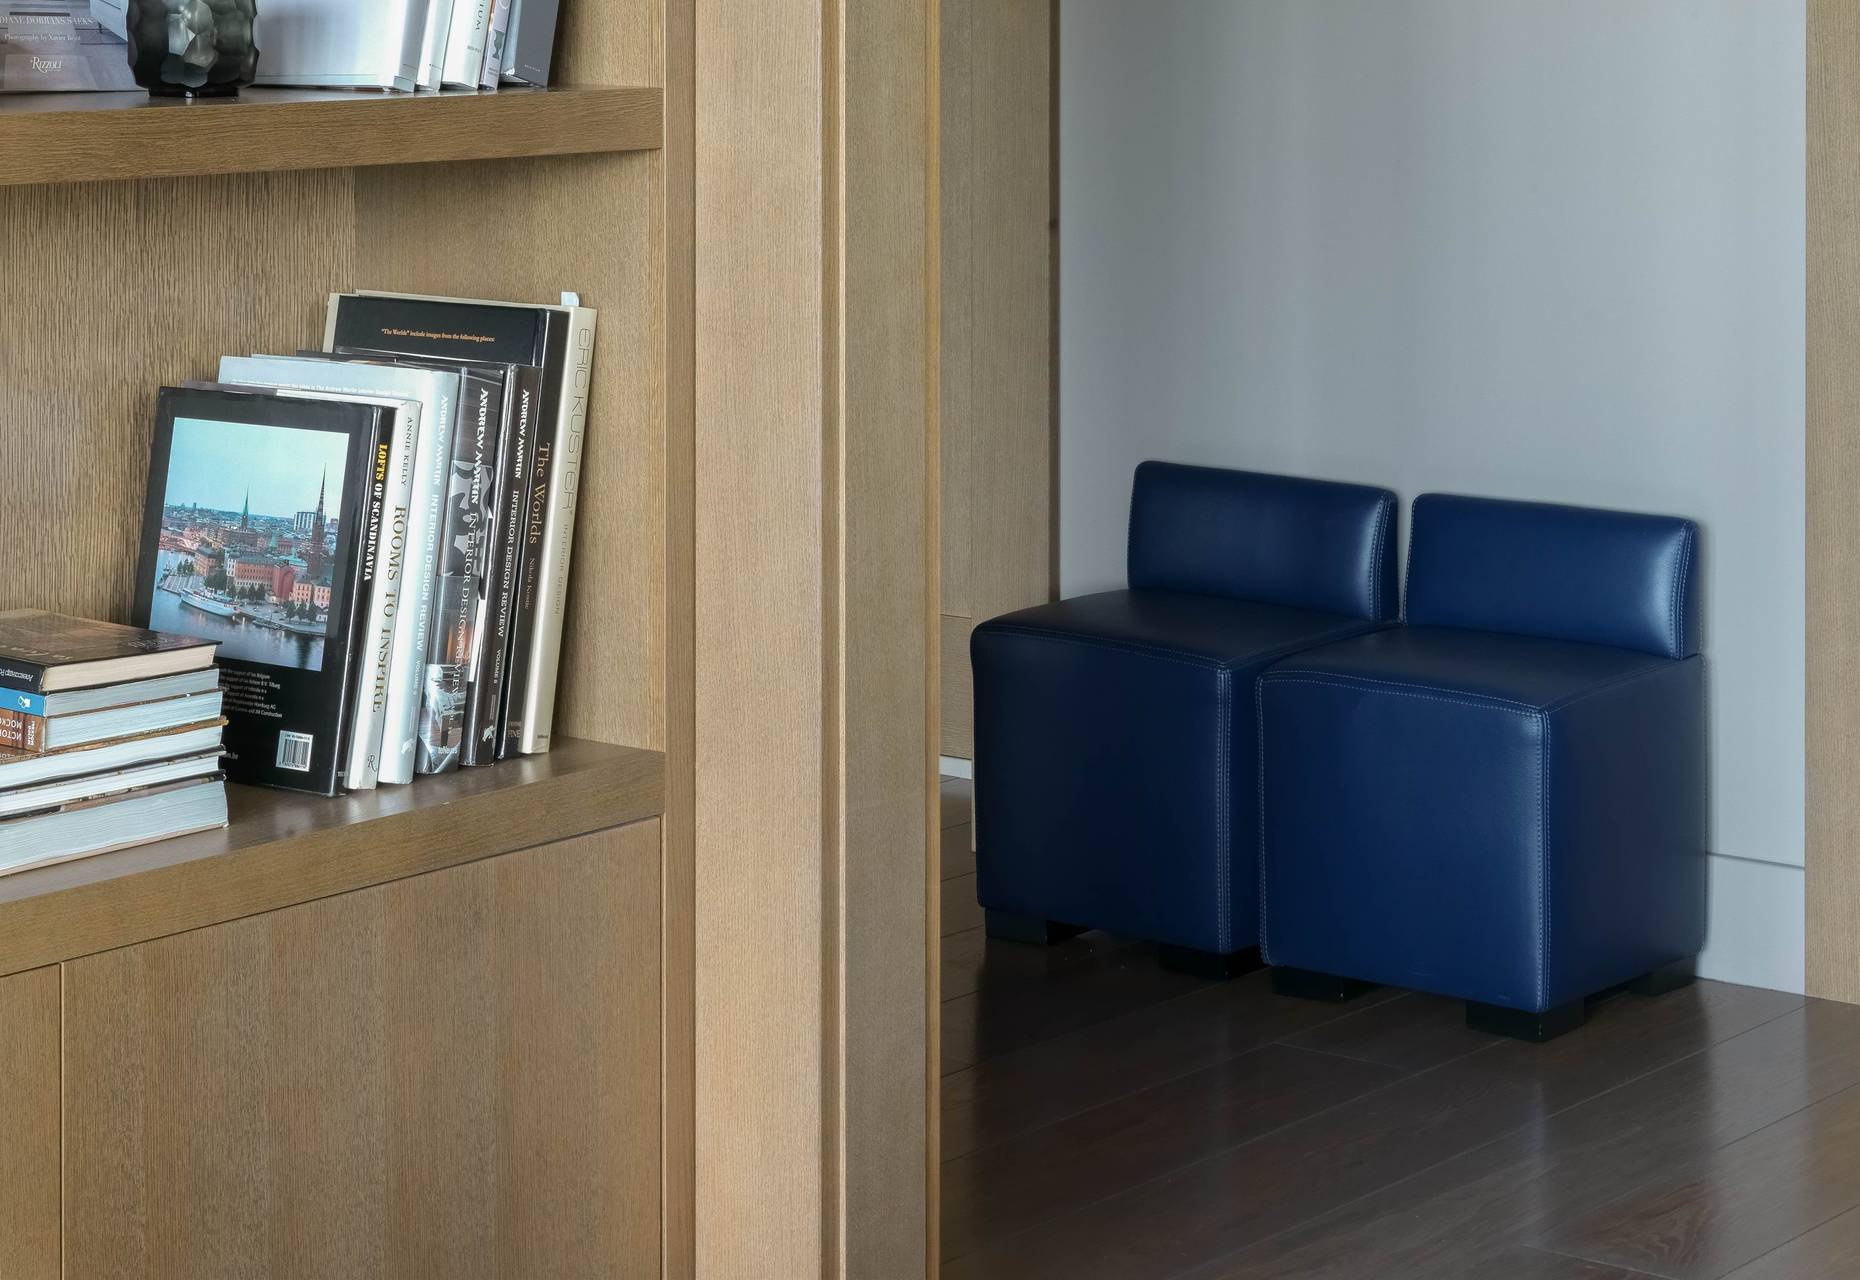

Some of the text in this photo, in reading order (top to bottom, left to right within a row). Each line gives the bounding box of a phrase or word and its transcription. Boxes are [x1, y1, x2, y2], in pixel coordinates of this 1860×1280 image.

[574, 328, 591, 389] ERIC
[438, 394, 448, 443] ANDREW
[476, 388, 488, 450] ANDREW
[520, 389, 530, 436] ANDREW
[401, 416, 414, 486] ANNIE KELLY
[432, 444, 444, 486] MARTIN
[472, 450, 482, 504] MARTIN
[515, 438, 525, 479] MARTIN
[536, 442, 550, 478] The
[562, 396, 584, 510] KUSTER
[364, 443, 388, 581] LOFTS OF SCANDINAVIA
[426, 494, 439, 552] INTERIOR
[508, 490, 519, 544] INTERIOR
[530, 482, 546, 544] Worlds
[464, 512, 479, 584] INTERIOR
[503, 546, 513, 589] DESIGN
[422, 555, 433, 600] DESIGN
[372, 504, 406, 713] ROOMS TO INSPIRE
[416, 604, 428, 652] REVIEW
[458, 588, 470, 641] DESIGN
[498, 592, 508, 638] REVIEW
[494, 648, 502, 678] VOLUME
